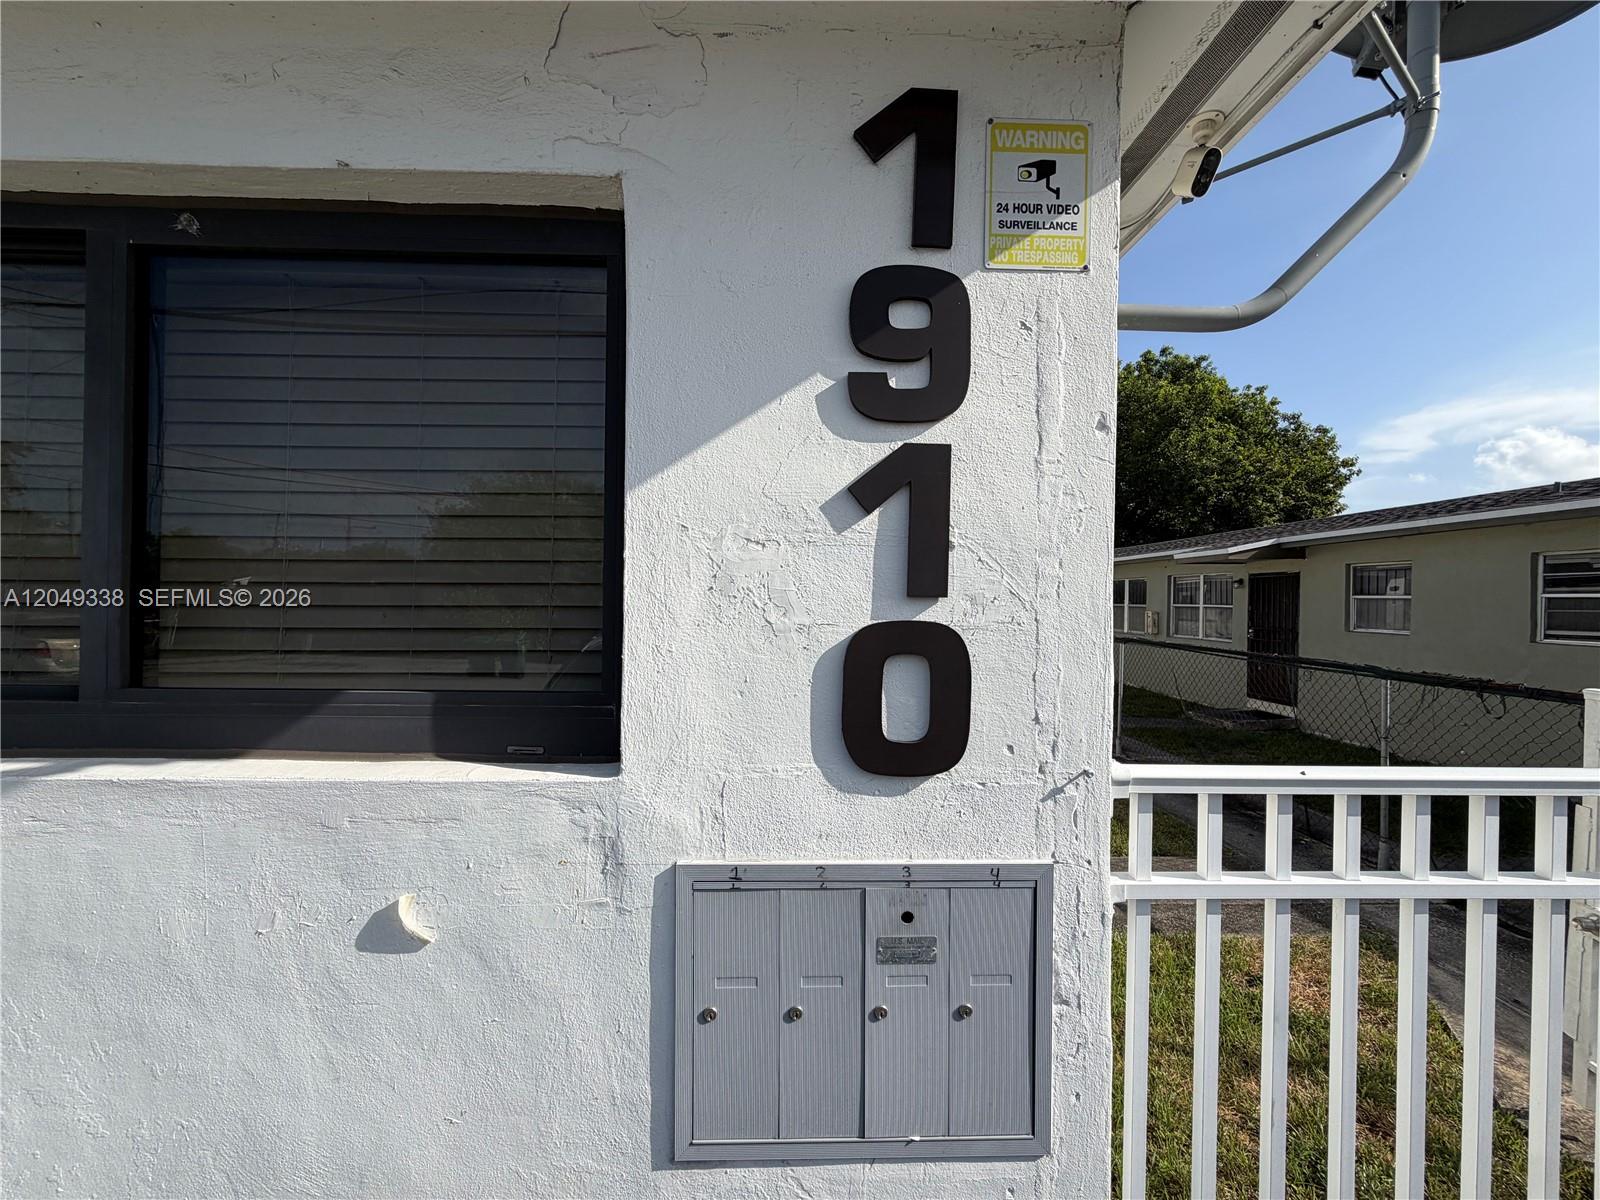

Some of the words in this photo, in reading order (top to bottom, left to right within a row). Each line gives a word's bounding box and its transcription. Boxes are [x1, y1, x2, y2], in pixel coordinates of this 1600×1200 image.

[994, 128, 1086, 150] WARNING
[996, 202, 1009, 214] 24
[1012, 203, 1043, 215] HOUR
[1046, 204, 1080, 216] VIDEO
[998, 219, 1078, 232] SURVEILLANCE
[990, 236, 1031, 249] PRIVATE
[1033, 238, 1085, 252] PROPERTY
[994, 250, 1009, 263] NO
[1011, 251, 1079, 264] TRESPASSING
[842, 87, 972, 778] 1910
[728, 866, 743, 880] 1
[815, 866, 829, 879] 2
[902, 866, 911, 878] 3
[990, 867, 1000, 881] 4
